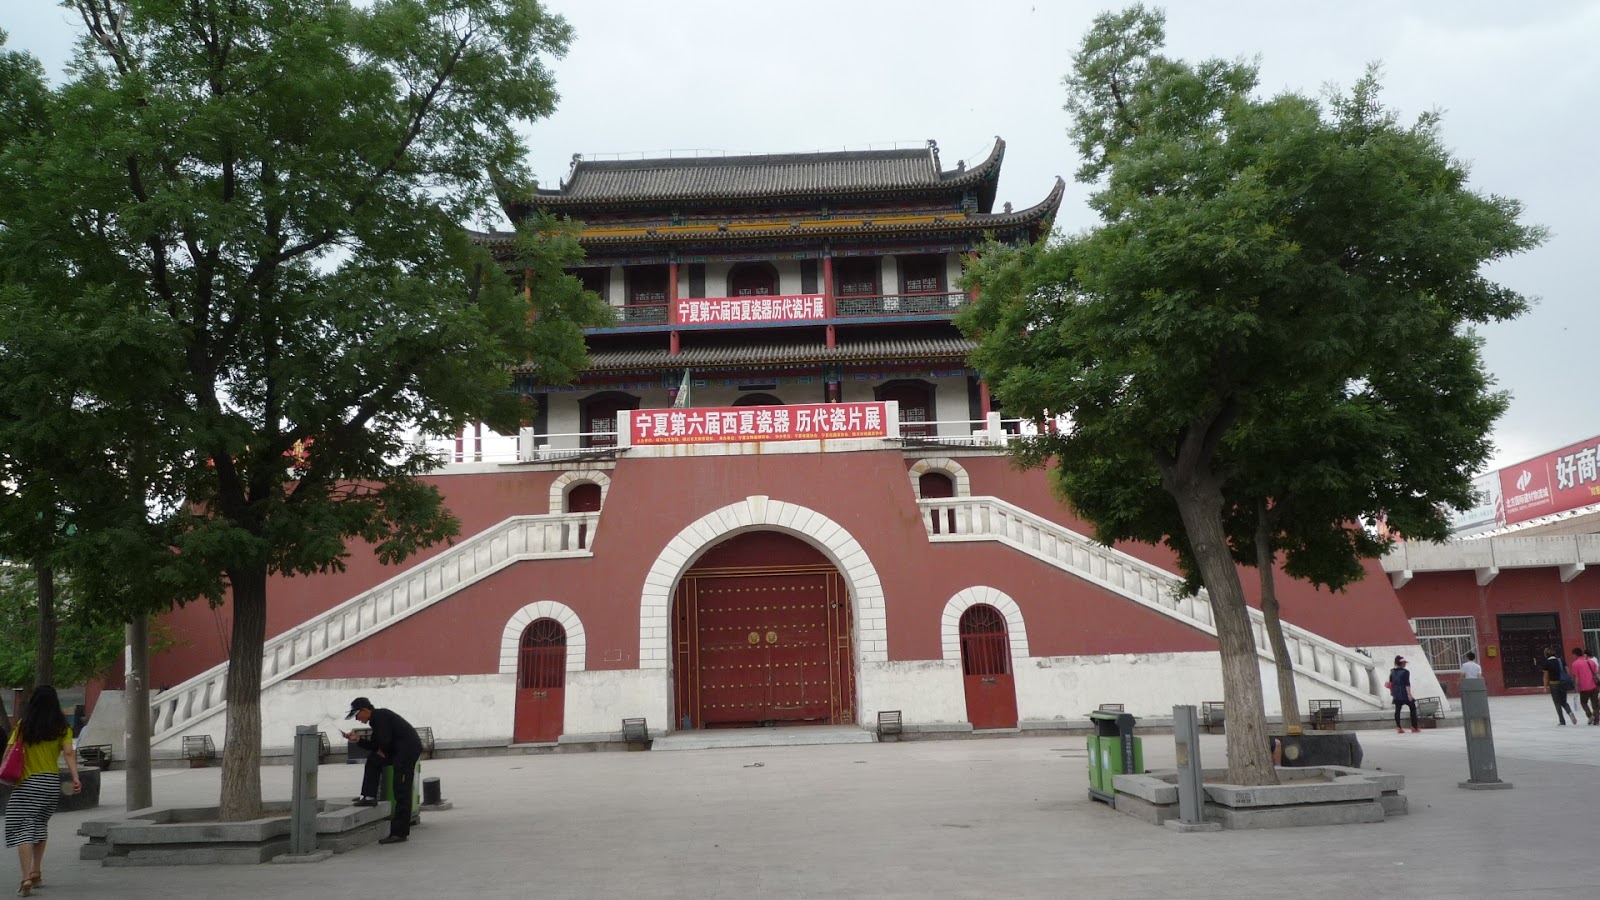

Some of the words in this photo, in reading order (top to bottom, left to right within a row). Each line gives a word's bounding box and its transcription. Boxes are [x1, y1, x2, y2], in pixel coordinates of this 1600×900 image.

[679, 297, 824, 323] 宁夏第六届西夏瓷器历代瓷片展
[636, 409, 790, 438] 宁夏第六届西夏瓷器
[795, 406, 881, 433] 历代瓷片展
[1556, 444, 1600, 490] 好商
